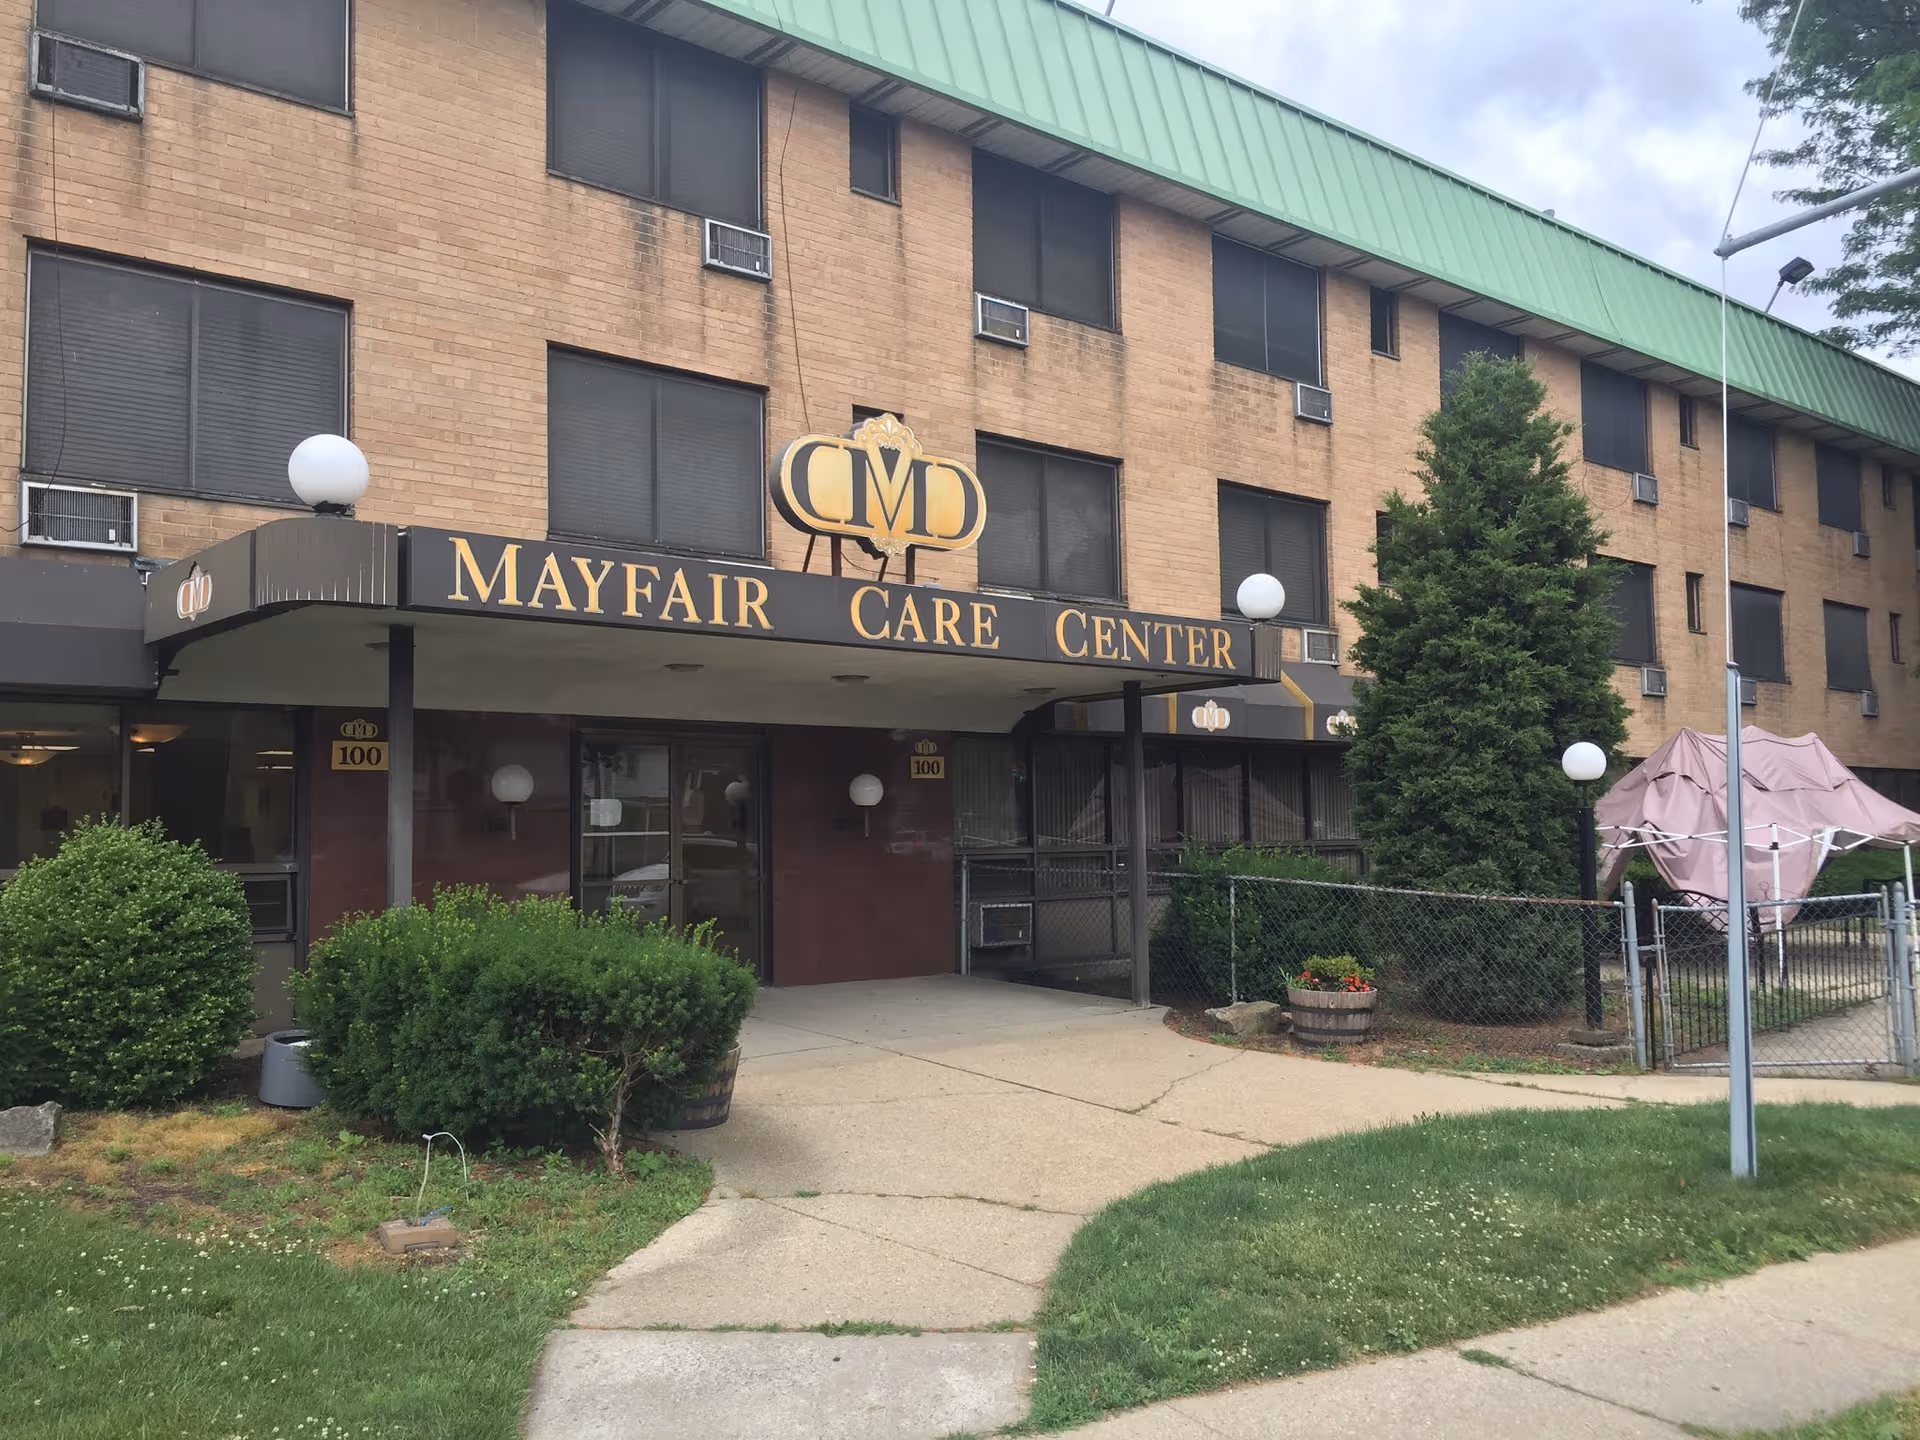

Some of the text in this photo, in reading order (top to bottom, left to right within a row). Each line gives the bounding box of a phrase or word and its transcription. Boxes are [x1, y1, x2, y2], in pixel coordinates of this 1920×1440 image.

[448, 537, 1236, 670] MAYFAIR CARE CENTER
[339, 745, 382, 765] 100
[913, 760, 940, 775] 100
